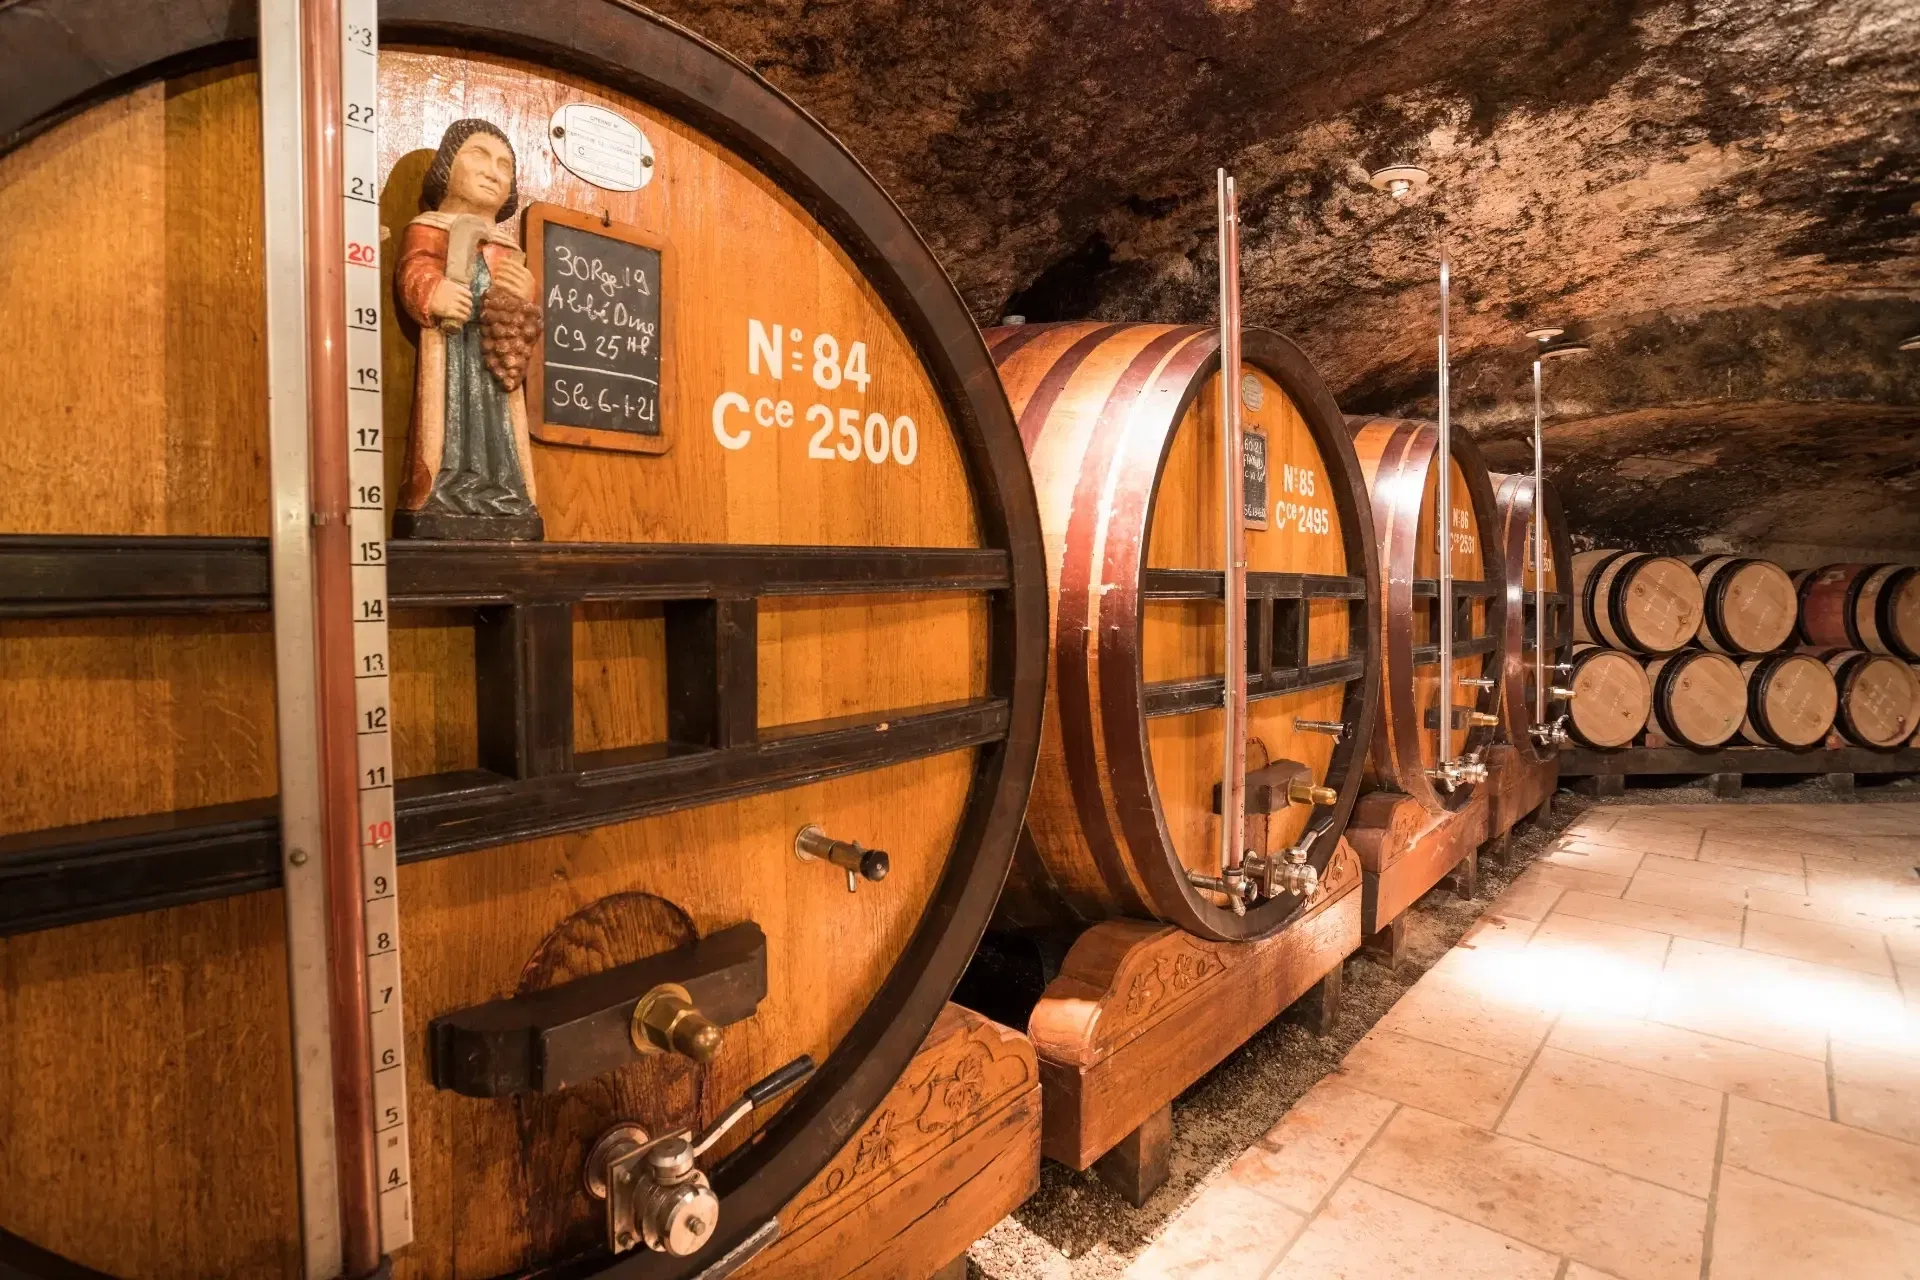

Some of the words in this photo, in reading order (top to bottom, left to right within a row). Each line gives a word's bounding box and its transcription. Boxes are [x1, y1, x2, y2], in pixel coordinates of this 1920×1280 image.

[351, 177, 375, 199] 21
[347, 242, 376, 263] 20
[354, 307, 377, 325] 19
[595, 335, 622, 360] 25
[356, 428, 379, 446] 17
[712, 391, 794, 450] Cce
[805, 403, 918, 466] 2500
[358, 486, 381, 504] 16
[1297, 505, 1329, 535] 2495
[360, 541, 382, 562] 15
[362, 599, 383, 618] 14
[363, 653, 385, 673] 13
[364, 706, 387, 729] 12
[366, 766, 386, 786] 11
[367, 821, 392, 842] 10
[374, 876, 388, 894] 9
[377, 932, 391, 950] 8
[381, 1048, 395, 1066] 6
[385, 1107, 399, 1124] 5
[387, 1167, 401, 1186] 4
